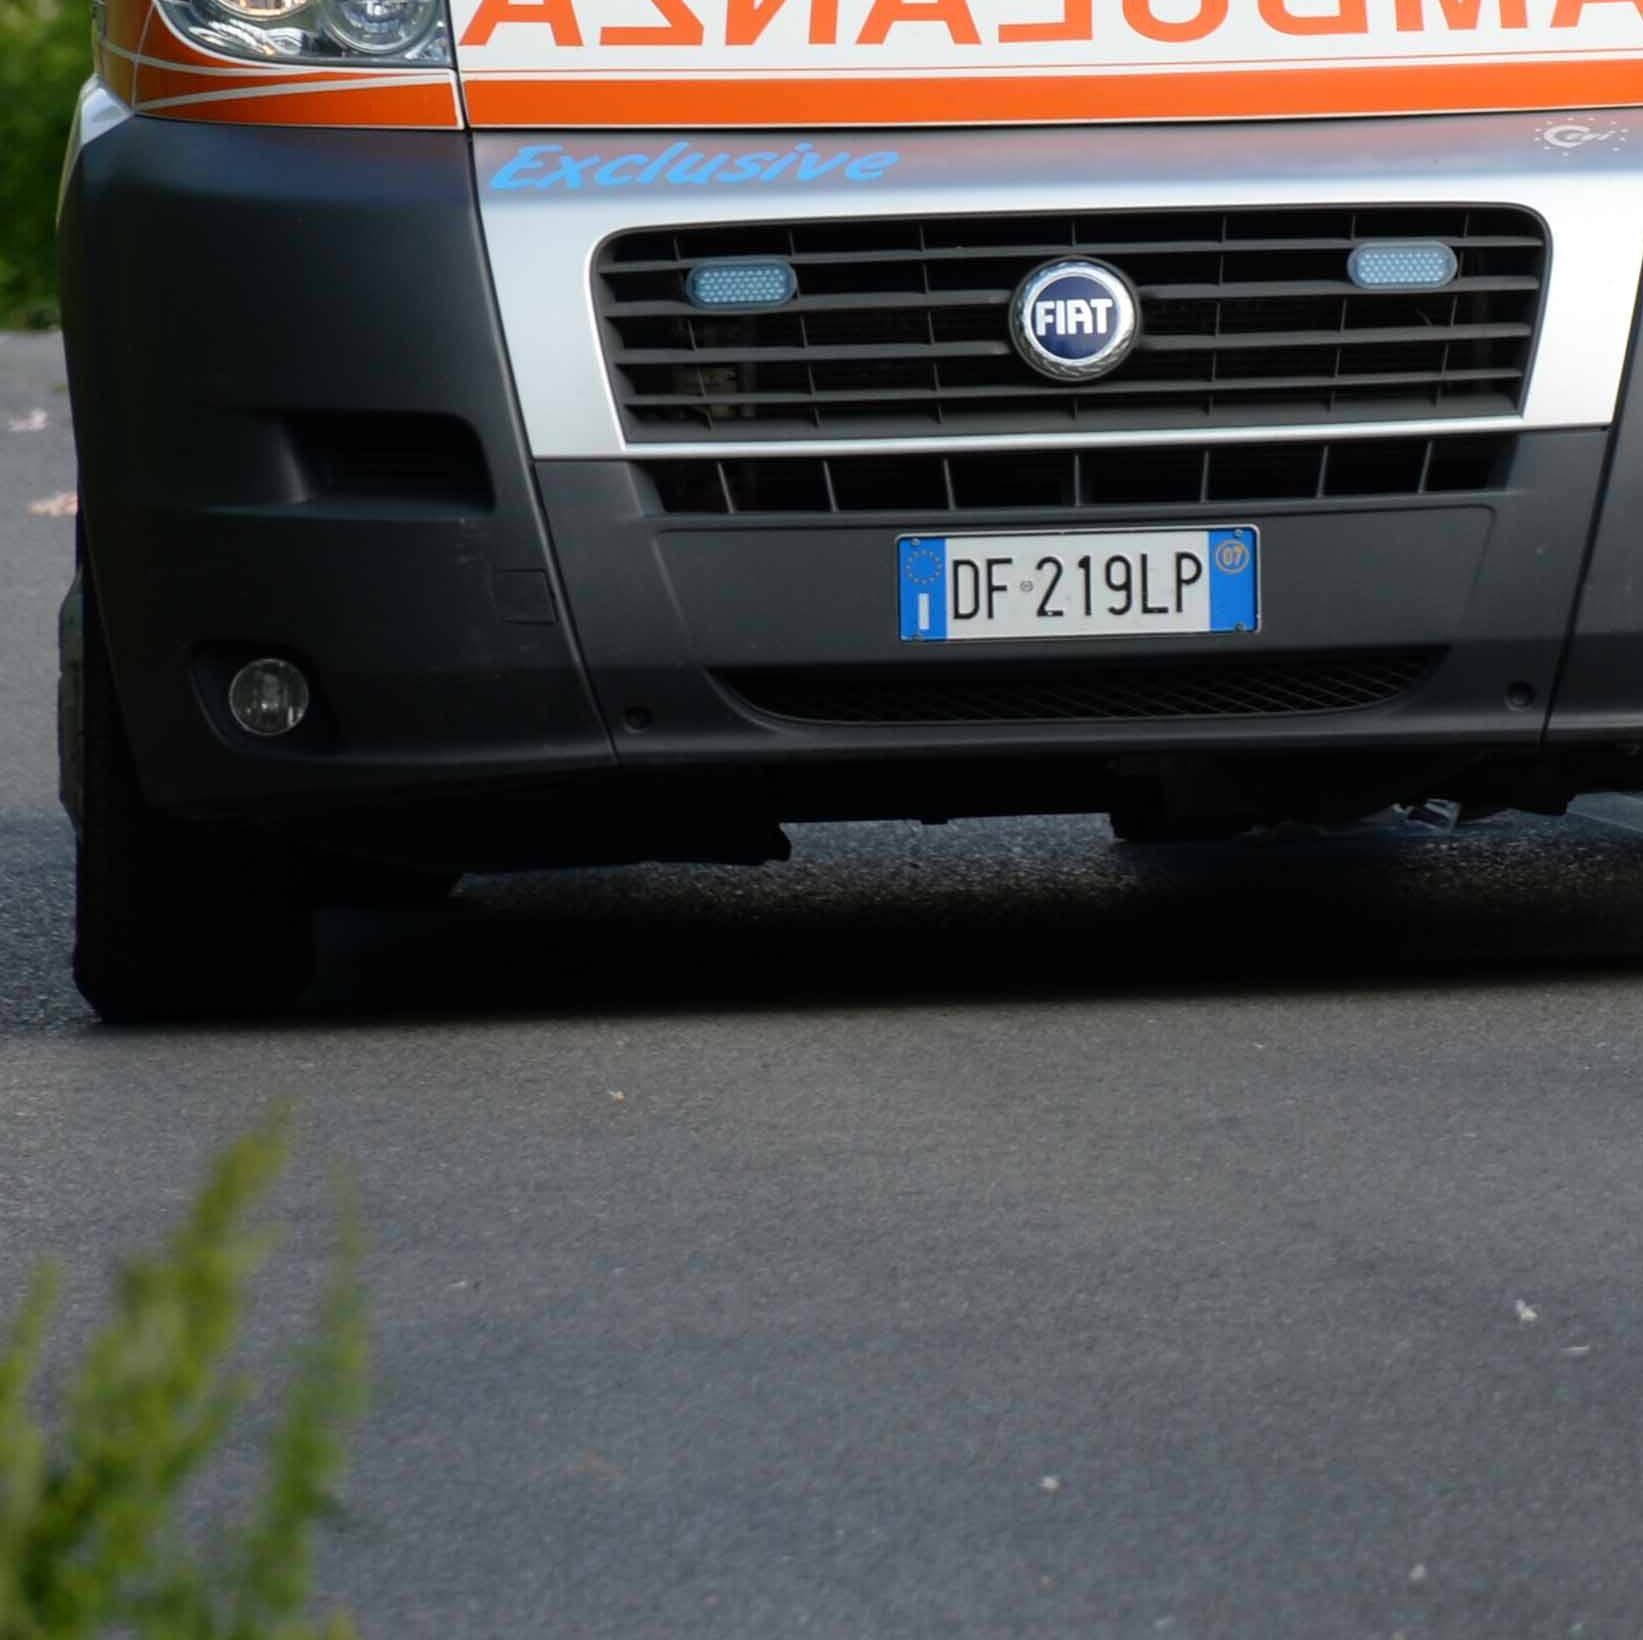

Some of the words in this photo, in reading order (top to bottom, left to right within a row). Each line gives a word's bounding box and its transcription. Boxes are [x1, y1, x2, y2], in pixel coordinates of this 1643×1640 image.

[490, 141, 900, 191] Exclusive
[1035, 298, 1117, 336] FIAT
[952, 557, 1013, 620] DF
[1035, 552, 1203, 618] 219LP
